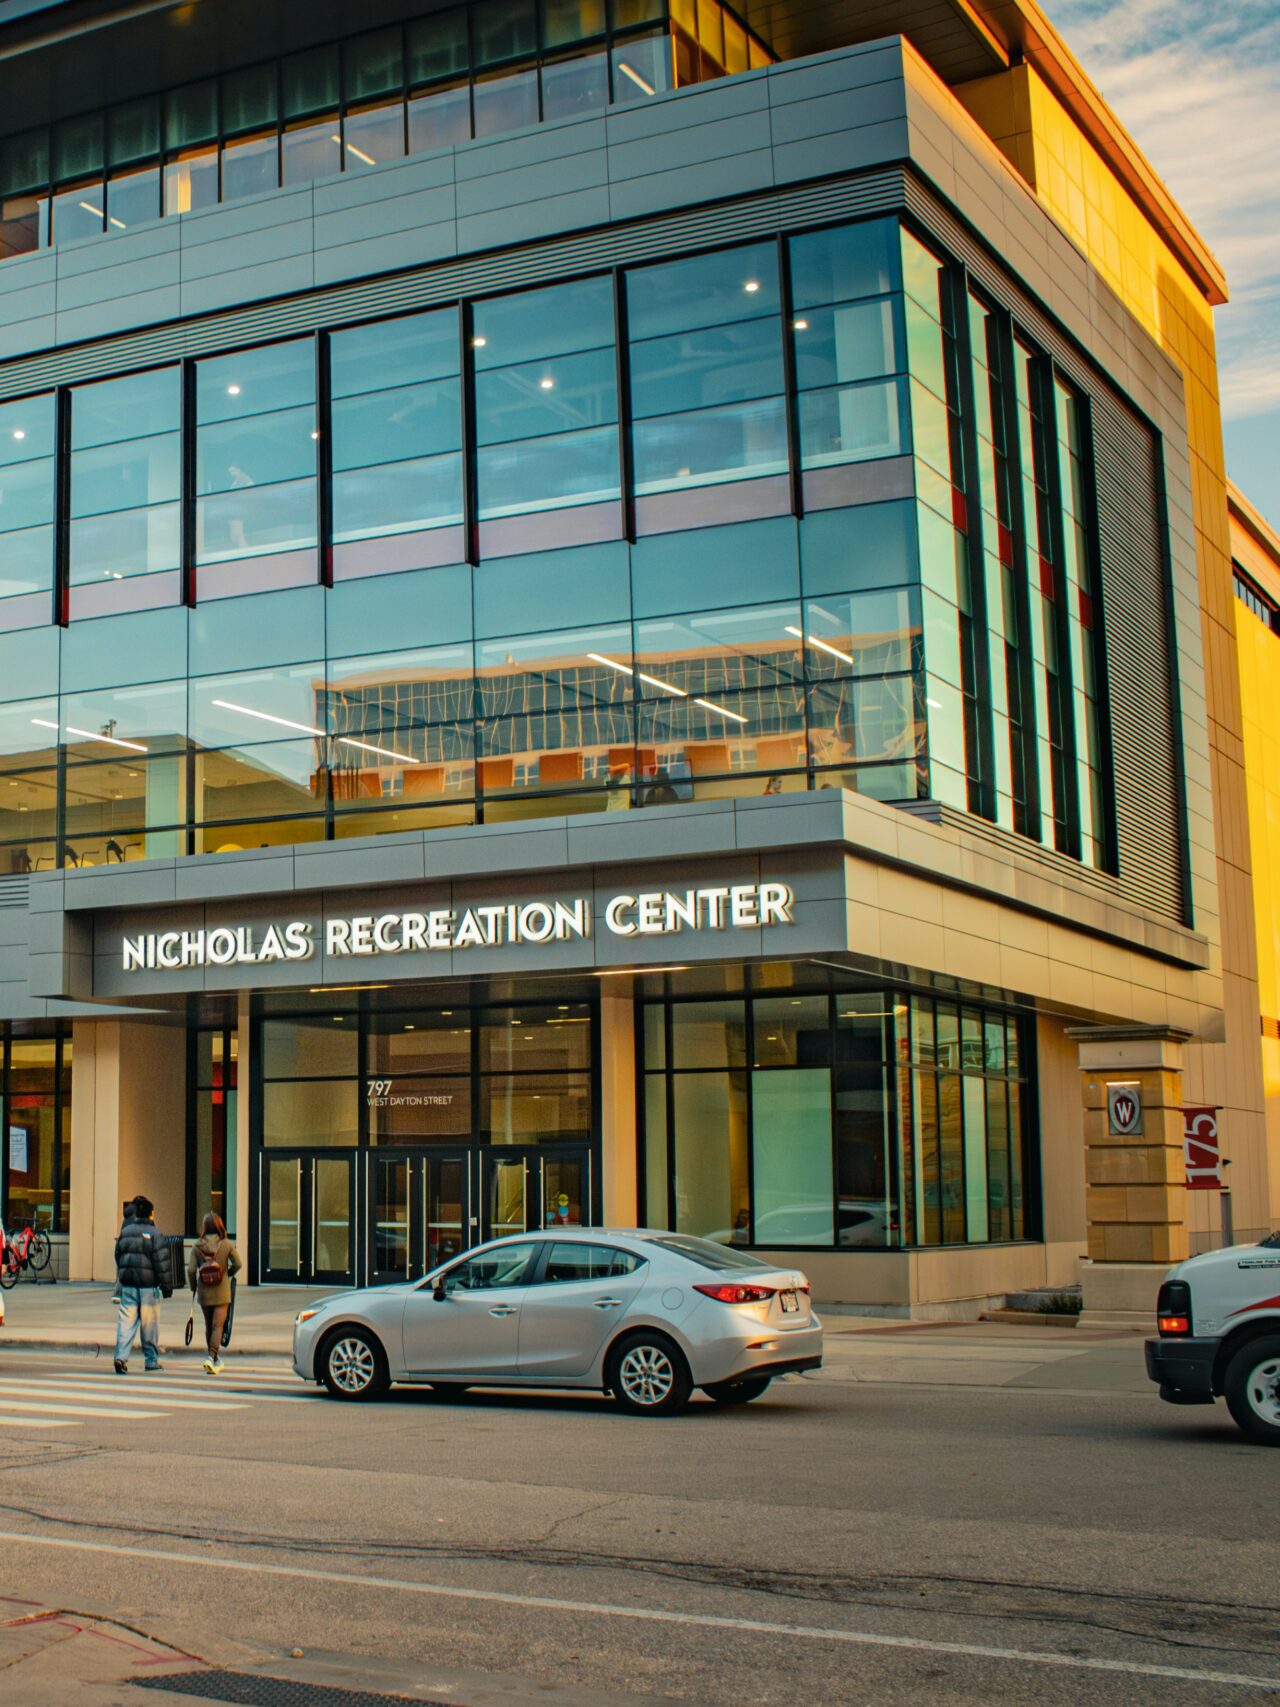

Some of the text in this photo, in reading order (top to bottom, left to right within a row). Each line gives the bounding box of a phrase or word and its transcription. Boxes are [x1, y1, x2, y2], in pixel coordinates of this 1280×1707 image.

[123, 883, 794, 970] NICHOLAS RECREATION CENTER
[367, 1081, 392, 1096] 797
[367, 1096, 453, 1106] WEST DAYTON STREET
[1116, 1101, 1132, 1123] W
[1183, 1114, 1221, 1183] 175
